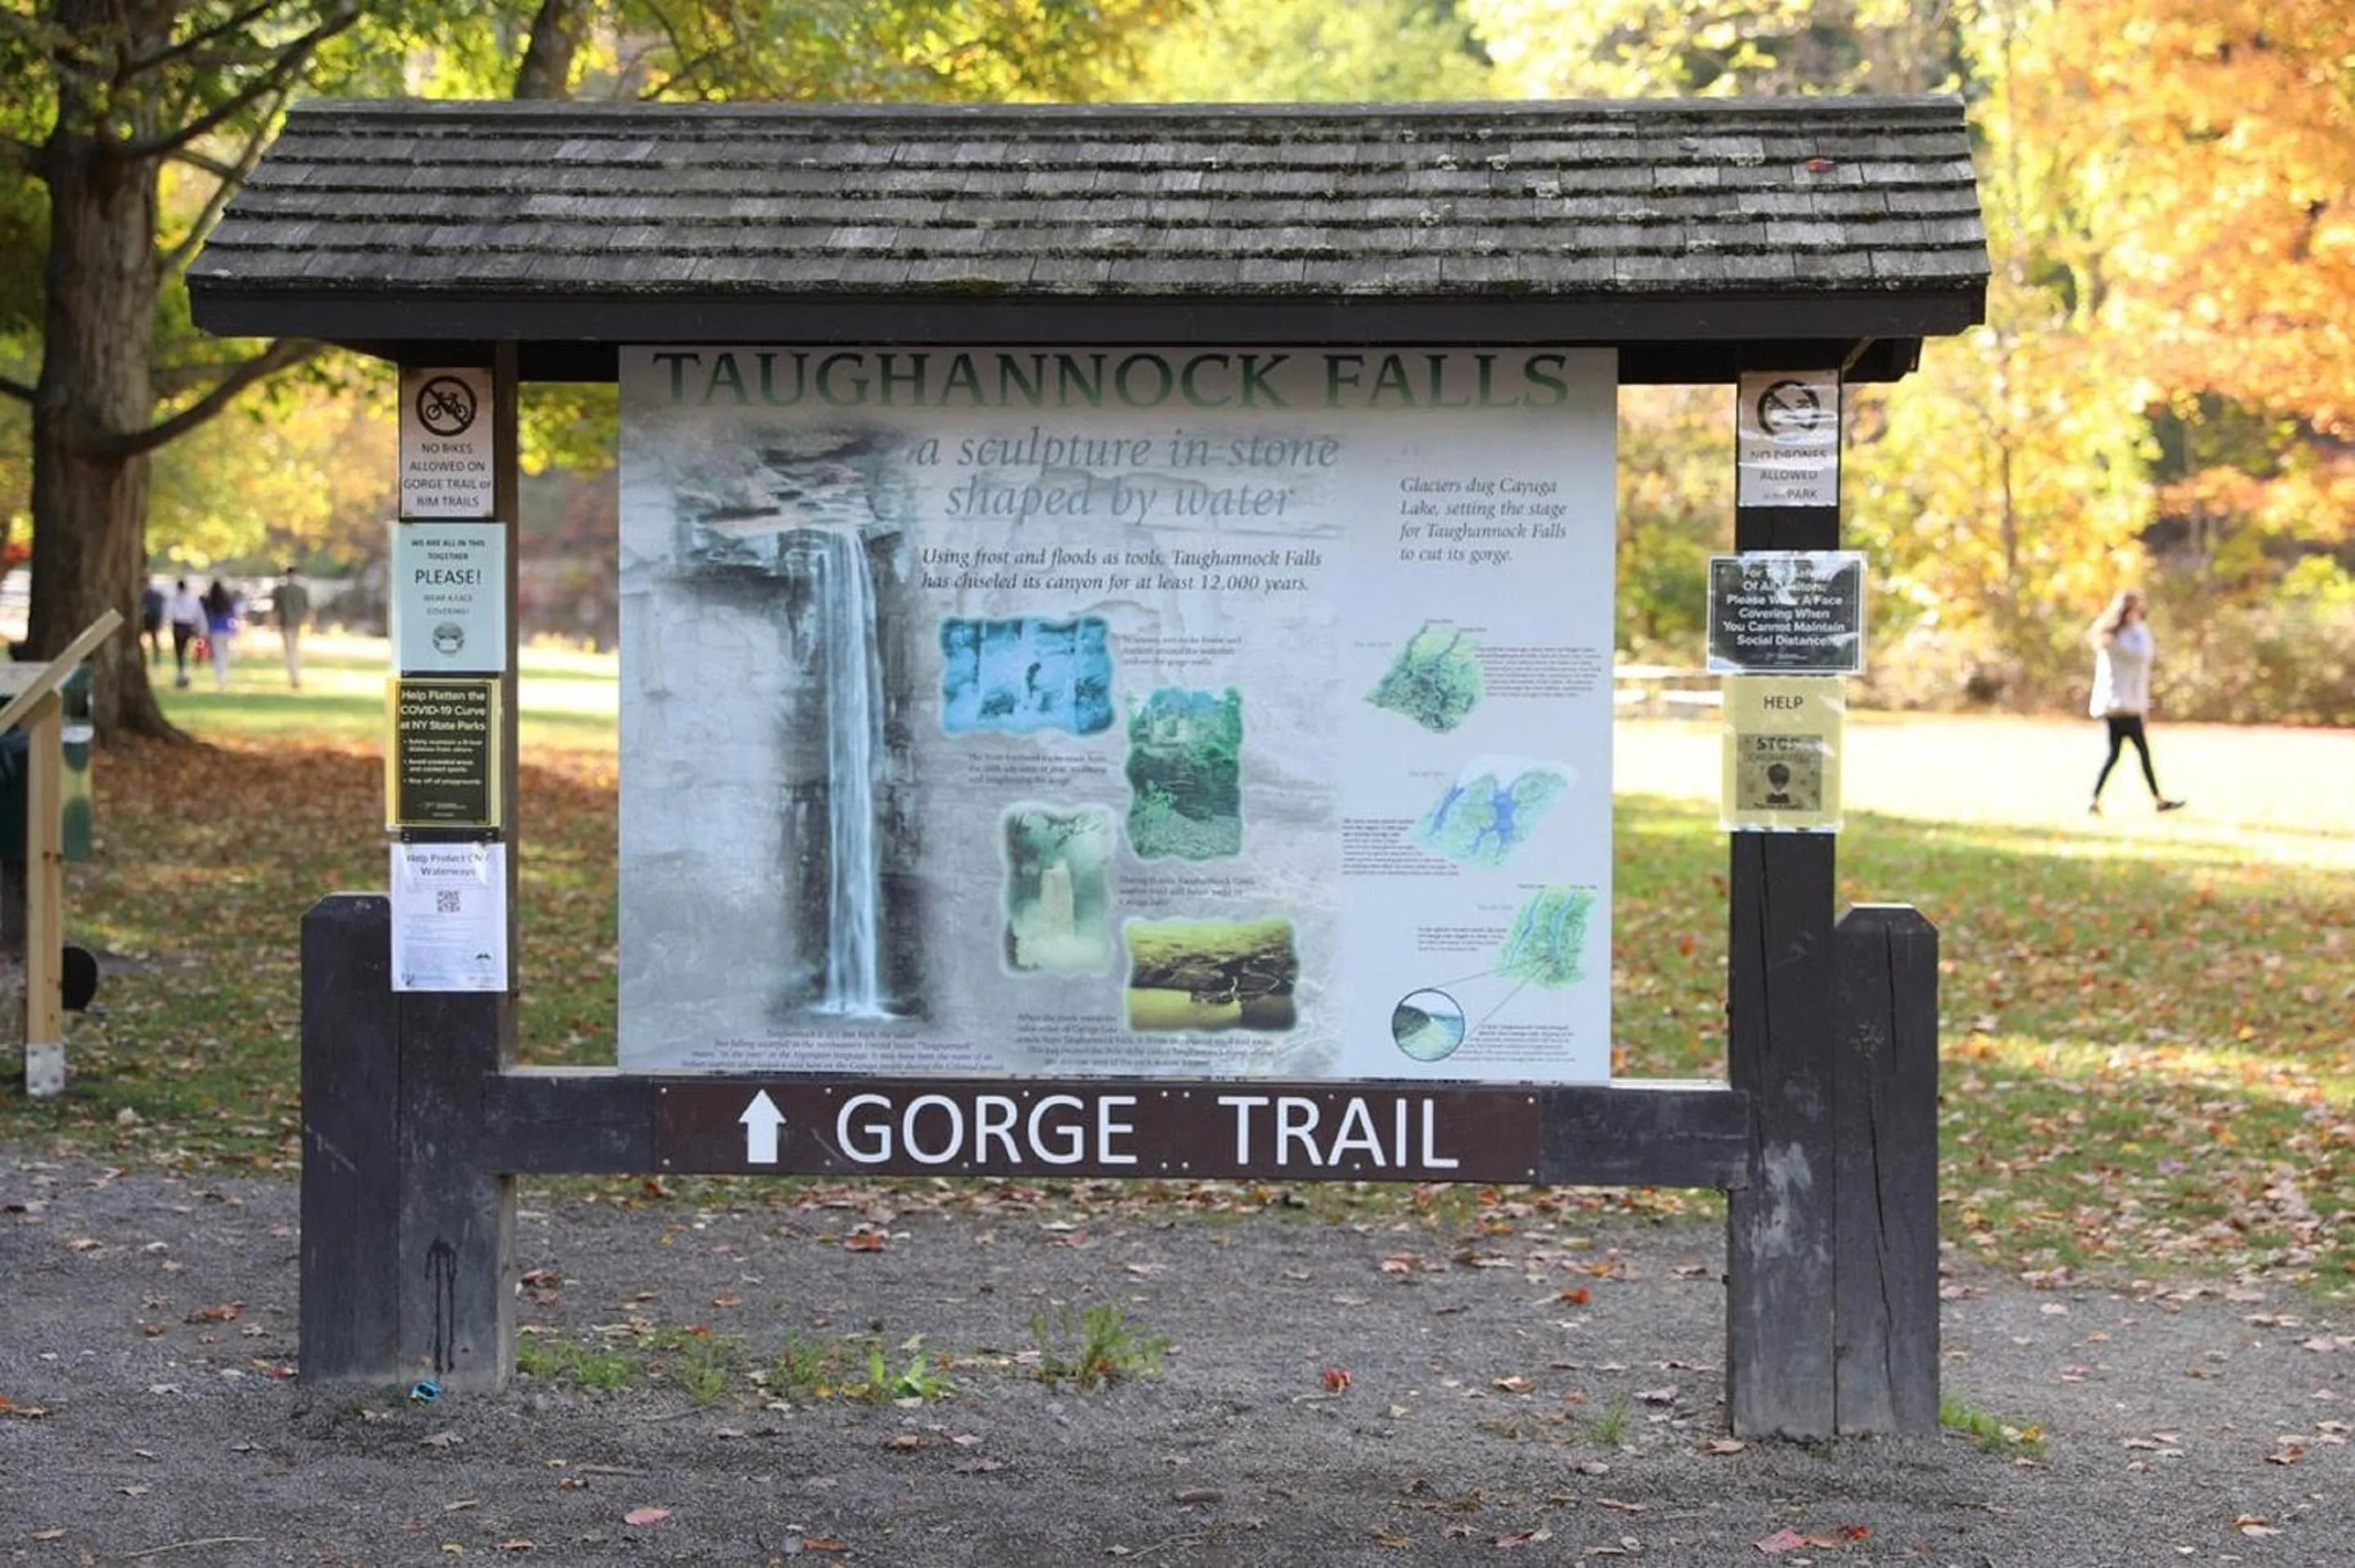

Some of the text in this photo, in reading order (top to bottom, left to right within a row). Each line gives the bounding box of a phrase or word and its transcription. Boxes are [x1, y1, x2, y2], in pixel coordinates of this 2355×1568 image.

[652, 352, 1570, 409] TAUGHANNOCK FALLS
[422, 443, 473, 453] NO BIKES
[916, 427, 1339, 477] a sculpture in stone
[410, 461, 485, 471] ALLOWED ON
[1760, 471, 1819, 480] ALLOWED
[403, 479, 442, 489] GORGE
[447, 479, 477, 489] TRAIL
[1400, 477, 1557, 495] Glaciers dug Cayuga
[1787, 490, 1818, 500] PARK
[417, 496, 480, 507] RIM TRAILS
[945, 476, 1295, 527] shaped by water
[1400, 500, 1568, 520] Lake, setting the stage
[1399, 522, 1567, 541] for Taughannock Falls
[922, 547, 1322, 568] Using frost and floods as tools, Taughannock Falls
[1400, 549, 1513, 565] to cut its gorge.
[415, 569, 482, 585] PLEASE!
[922, 573, 949, 589] has
[954, 573, 1017, 589] chiseled
[1023, 575, 1040, 589] its
[1046, 576, 1102, 593] canyon
[1107, 574, 1130, 593] for
[1136, 576, 1151, 589] at
[1158, 575, 1193, 589] least
[1265, 578, 1308, 594] years.
[1726, 594, 1766, 605] Please
[1814, 594, 1843, 605] Face
[1738, 608, 1831, 620] Covering When
[1723, 621, 1846, 632] You Cannot Maintain
[1737, 634, 1773, 646] Social
[401, 690, 486, 701] Help Flatten the
[1764, 696, 1804, 710] HELP
[401, 706, 486, 716] COVID-19 Curve
[412, 720, 428, 730] NY
[458, 720, 486, 731] Parks
[836, 1094, 1459, 1169] GORGE TRAIL
